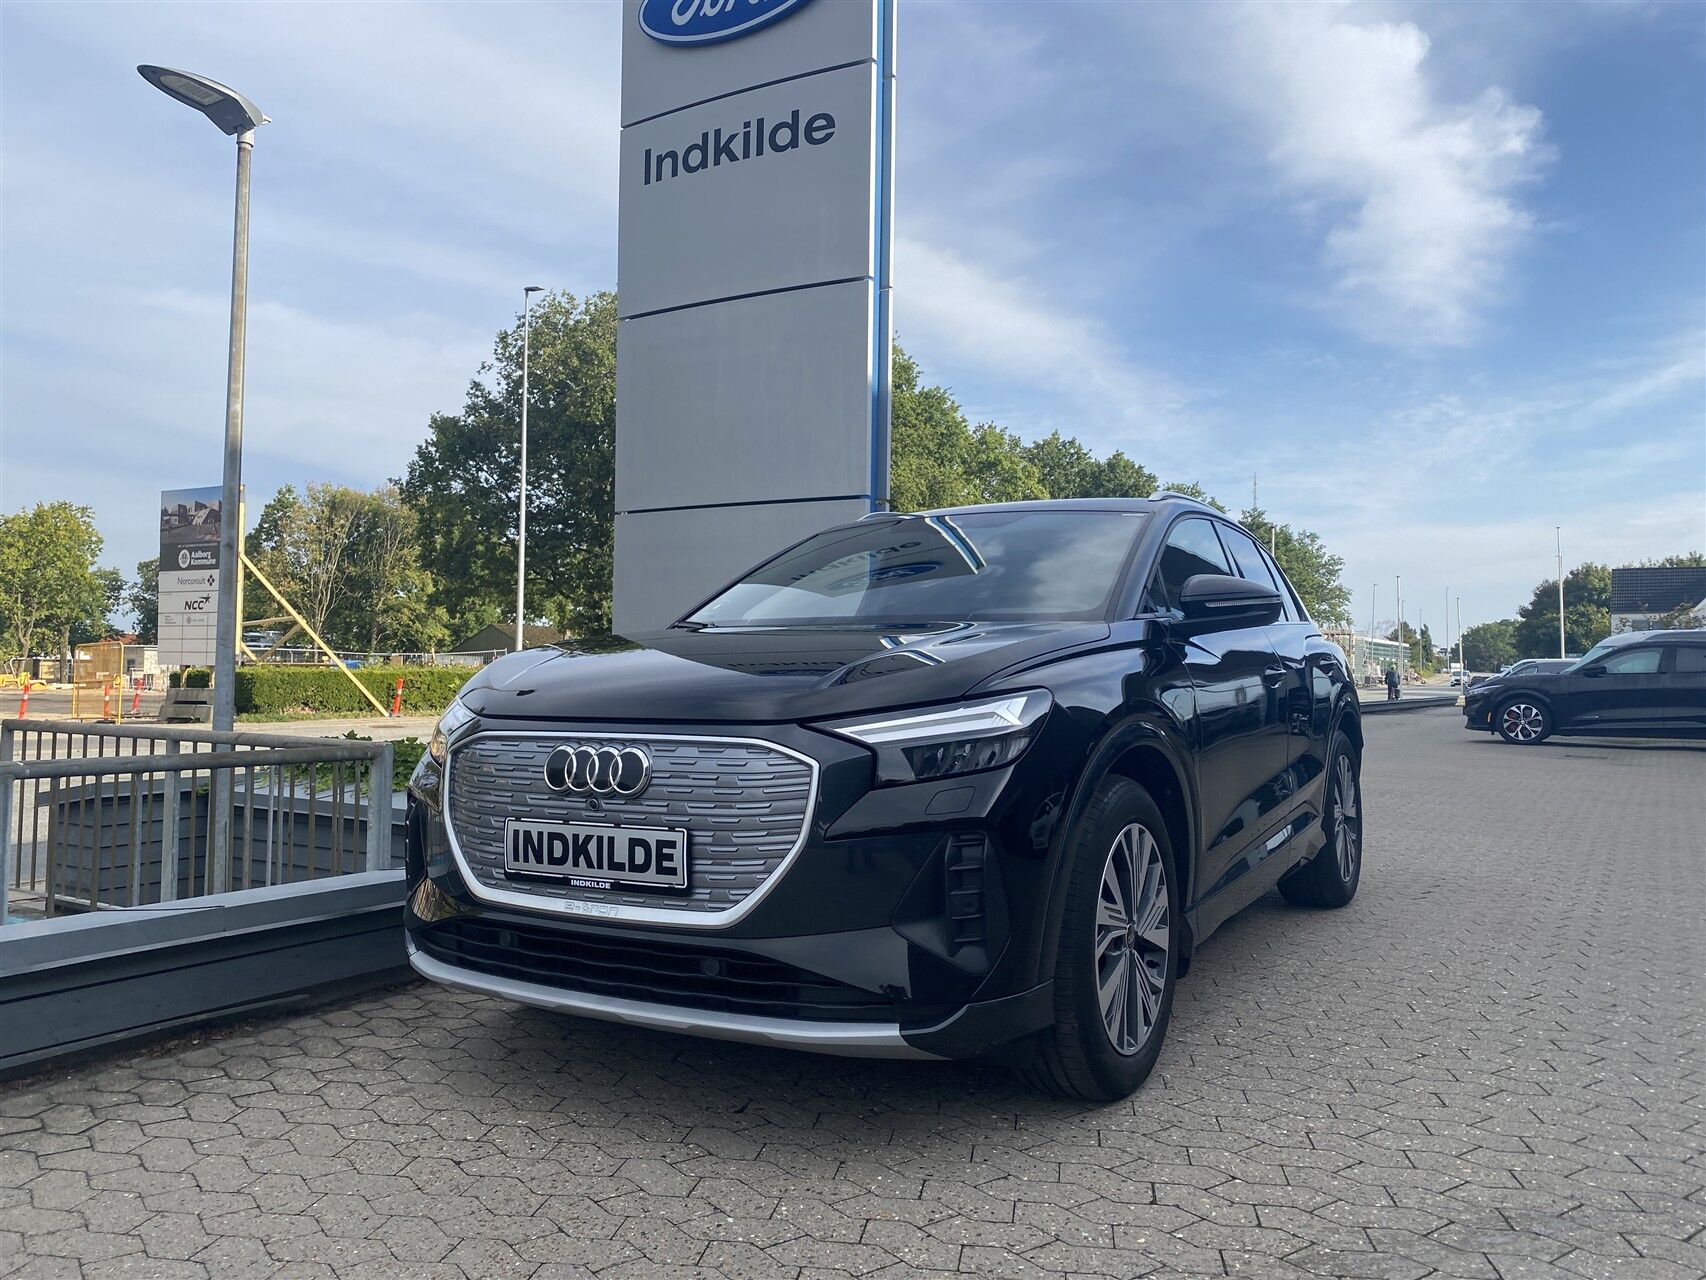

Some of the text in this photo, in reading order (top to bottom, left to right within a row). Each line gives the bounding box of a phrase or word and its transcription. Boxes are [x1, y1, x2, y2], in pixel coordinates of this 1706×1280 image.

[644, 110, 836, 185] Indkilde
[191, 551, 211, 559] Aalborg
[184, 601, 204, 610] NCC
[512, 829, 677, 876] INDKILDE
[570, 879, 611, 889] INDKILDE
[565, 901, 619, 916] e-tron
